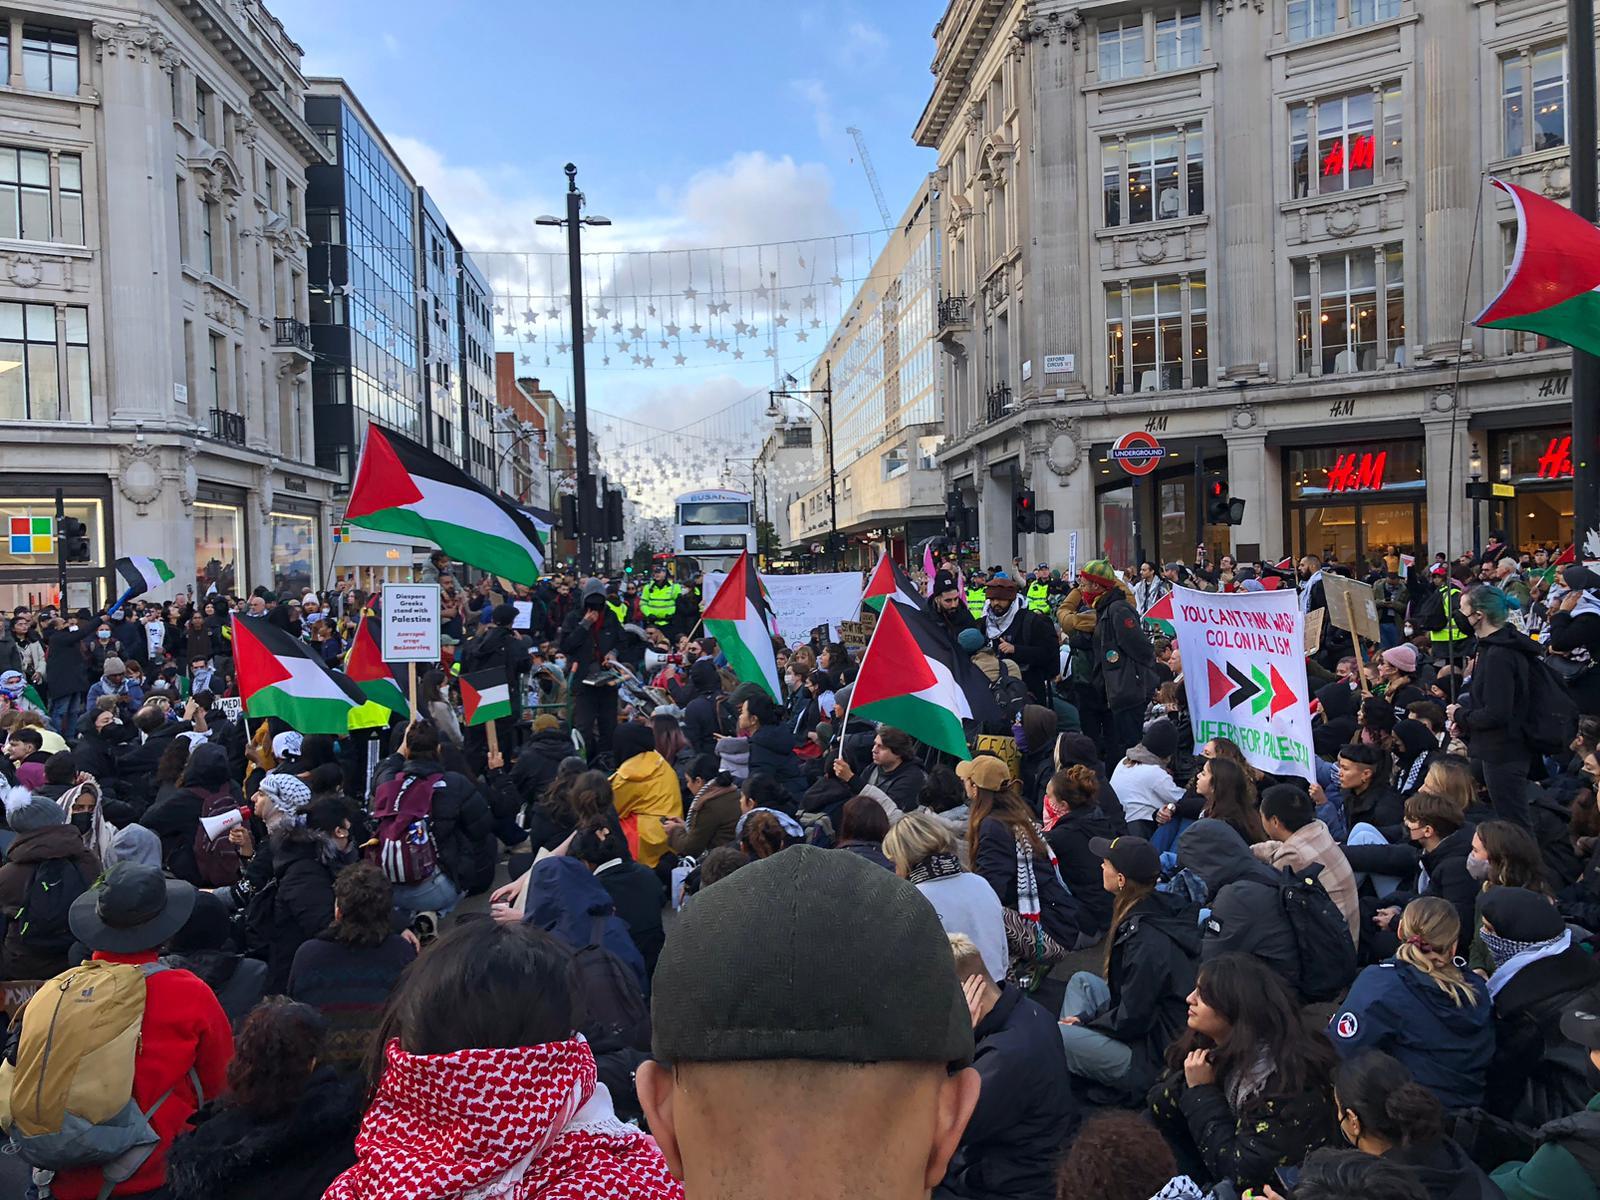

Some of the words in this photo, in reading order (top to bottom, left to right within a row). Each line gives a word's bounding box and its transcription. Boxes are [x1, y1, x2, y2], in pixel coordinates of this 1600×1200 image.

[1538, 377, 1568, 397] H&M
[1330, 400, 1355, 417] H&M
[1145, 416, 1168, 432] H&M
[1114, 449, 1163, 457] UNDERGROUND
[1328, 451, 1387, 494] H&M
[1181, 605, 1207, 624] YOU
[1206, 630, 1292, 656] COLONIALISM
